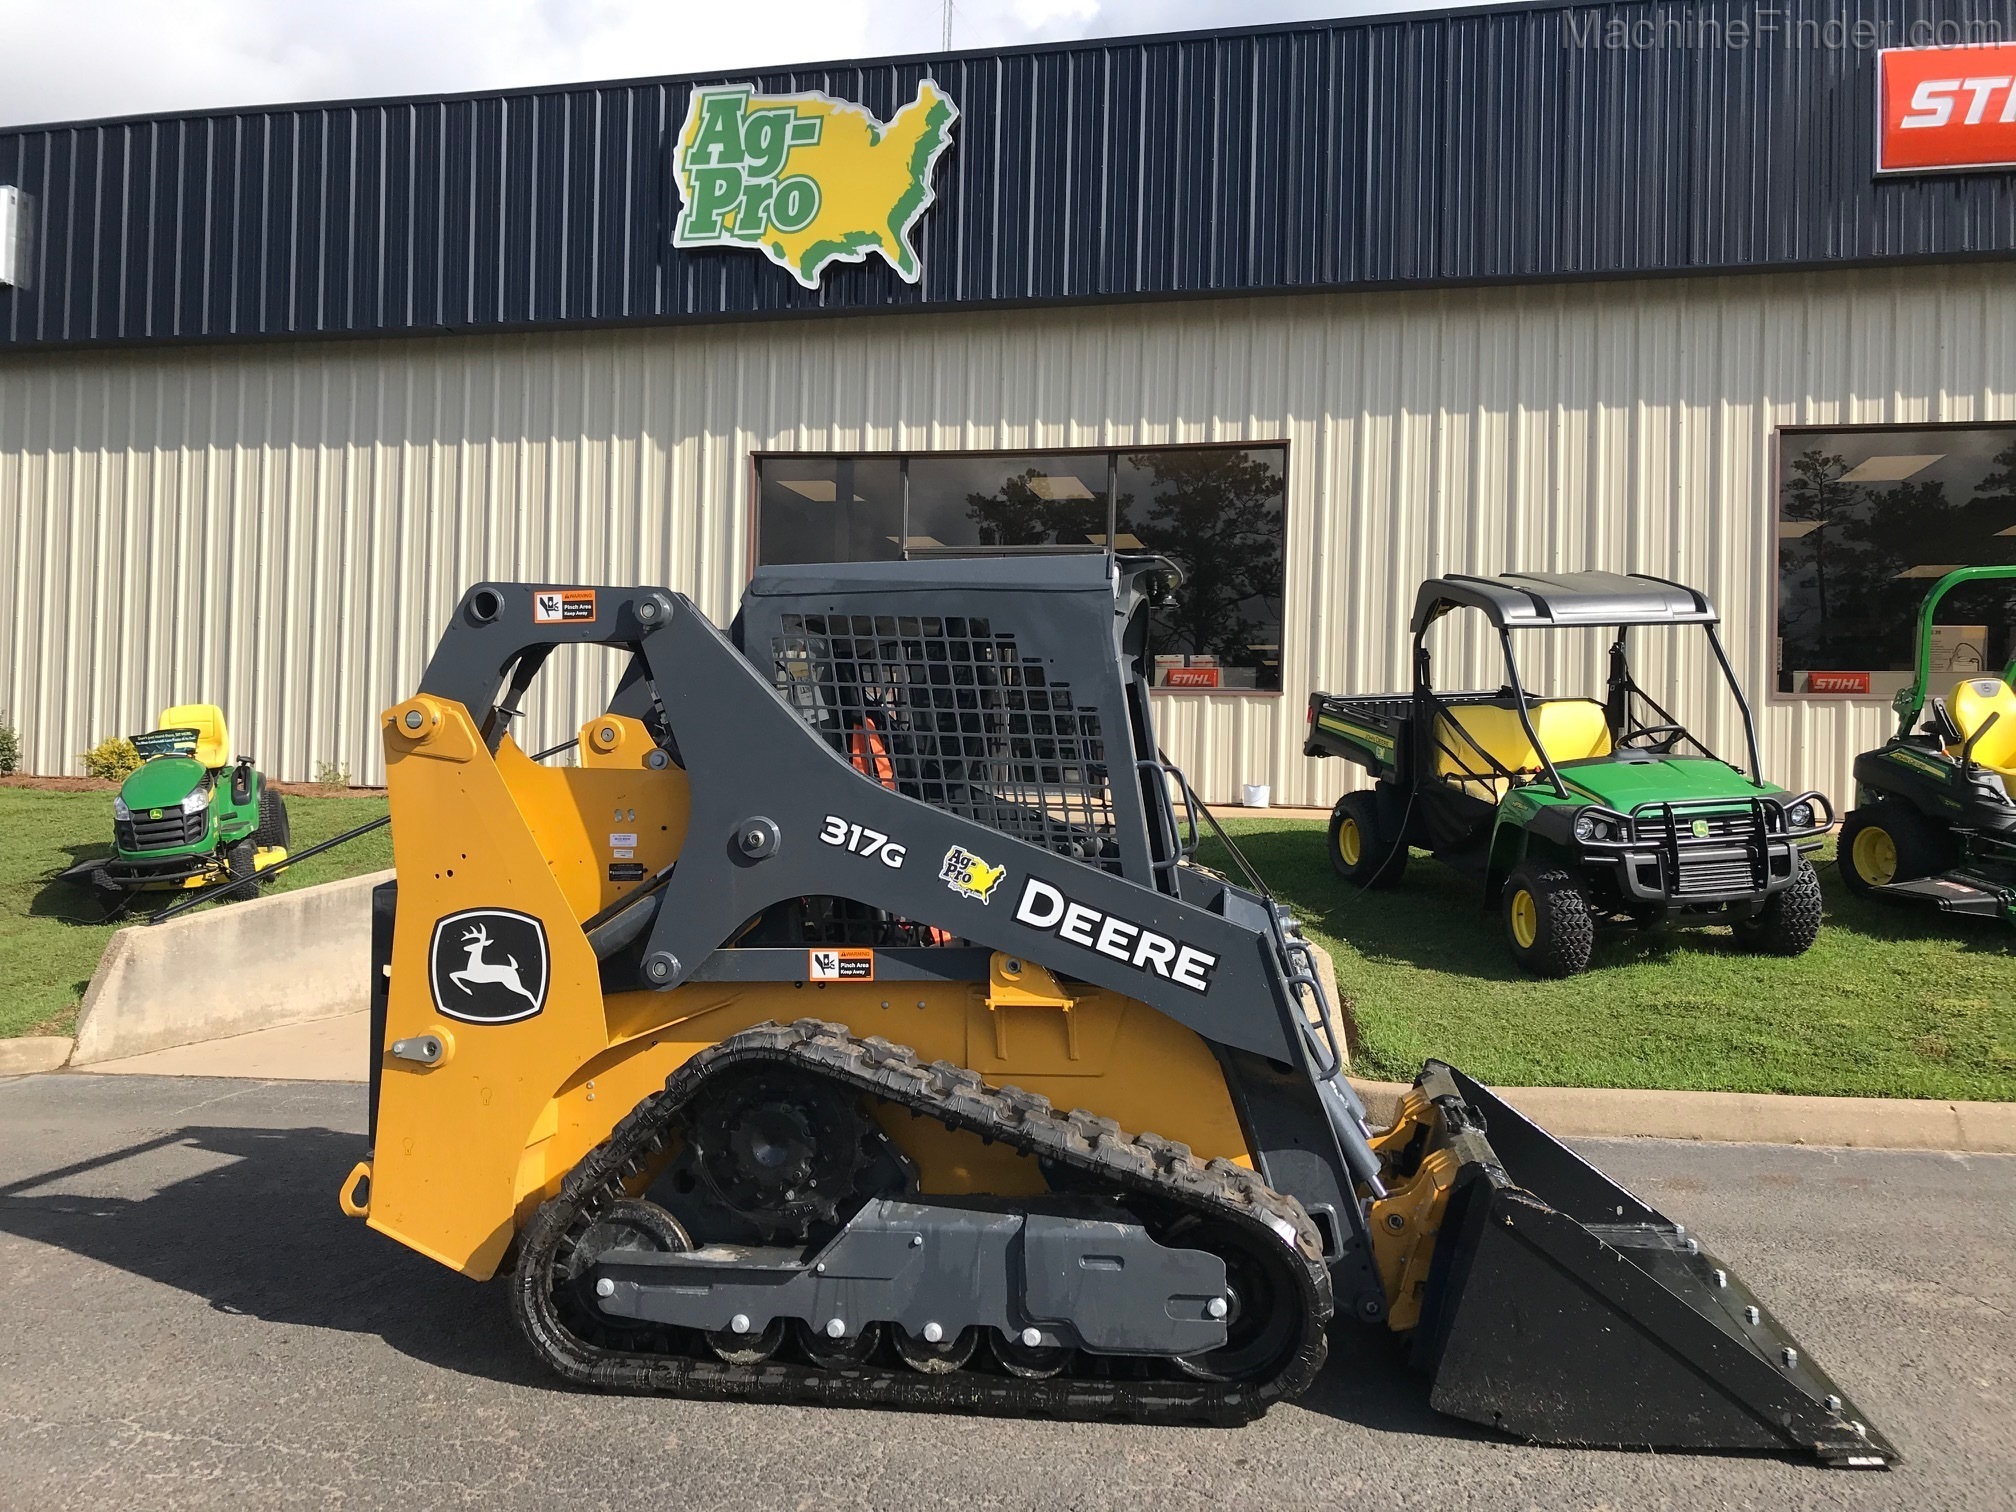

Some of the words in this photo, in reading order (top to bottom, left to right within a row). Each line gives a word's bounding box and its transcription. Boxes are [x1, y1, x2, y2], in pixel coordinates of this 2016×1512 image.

[682, 90, 824, 180] Ag-
[680, 166, 822, 240] Pro
[1171, 674, 1213, 684] STIHL
[1814, 678, 1864, 690] STIHL
[819, 815, 907, 868] 317G
[948, 849, 977, 870] Ag-
[942, 862, 972, 883] Pro
[1015, 878, 1216, 991] DEERE
